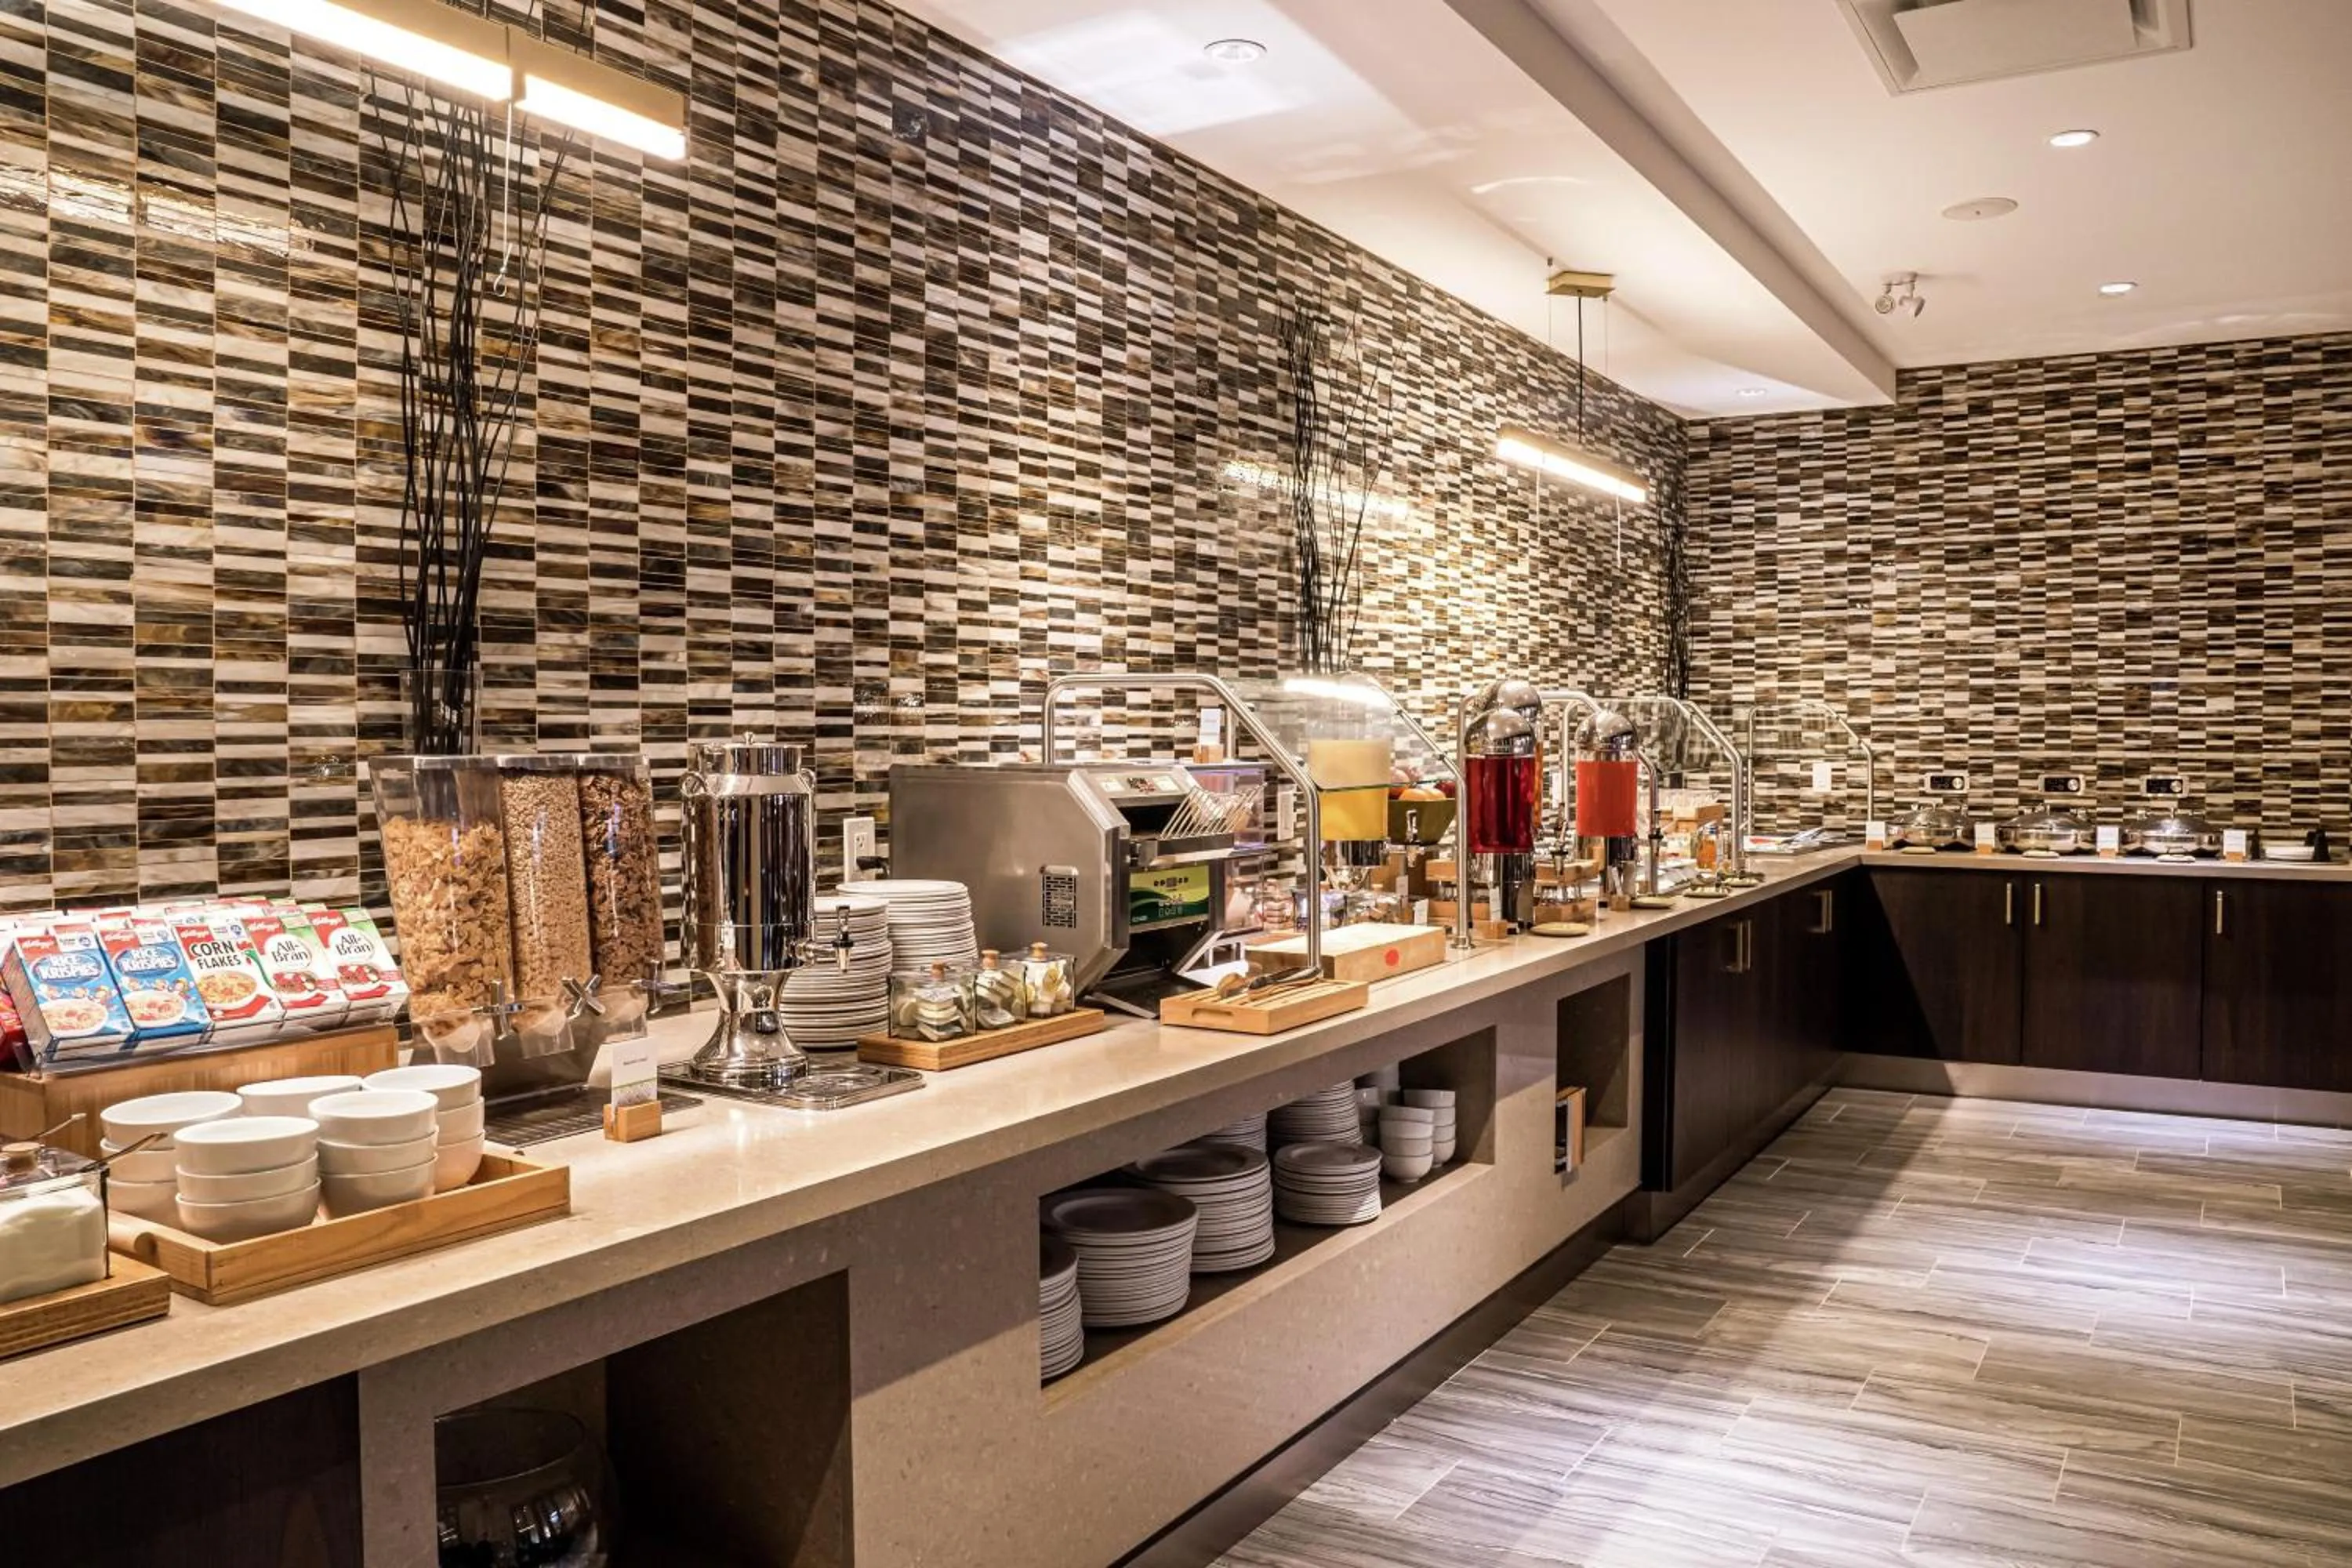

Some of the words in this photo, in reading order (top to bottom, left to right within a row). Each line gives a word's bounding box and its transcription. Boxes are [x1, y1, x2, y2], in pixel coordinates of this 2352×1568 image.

[131, 947, 160, 959] RICE
[191, 940, 235, 957] CORN
[336, 943, 371, 956] Bran
[50, 954, 81, 965] RICE
[120, 954, 176, 971] KRISPIES
[197, 954, 241, 970] FLAKES
[271, 950, 308, 963] Bran
[38, 963, 100, 979] KRISPIES
